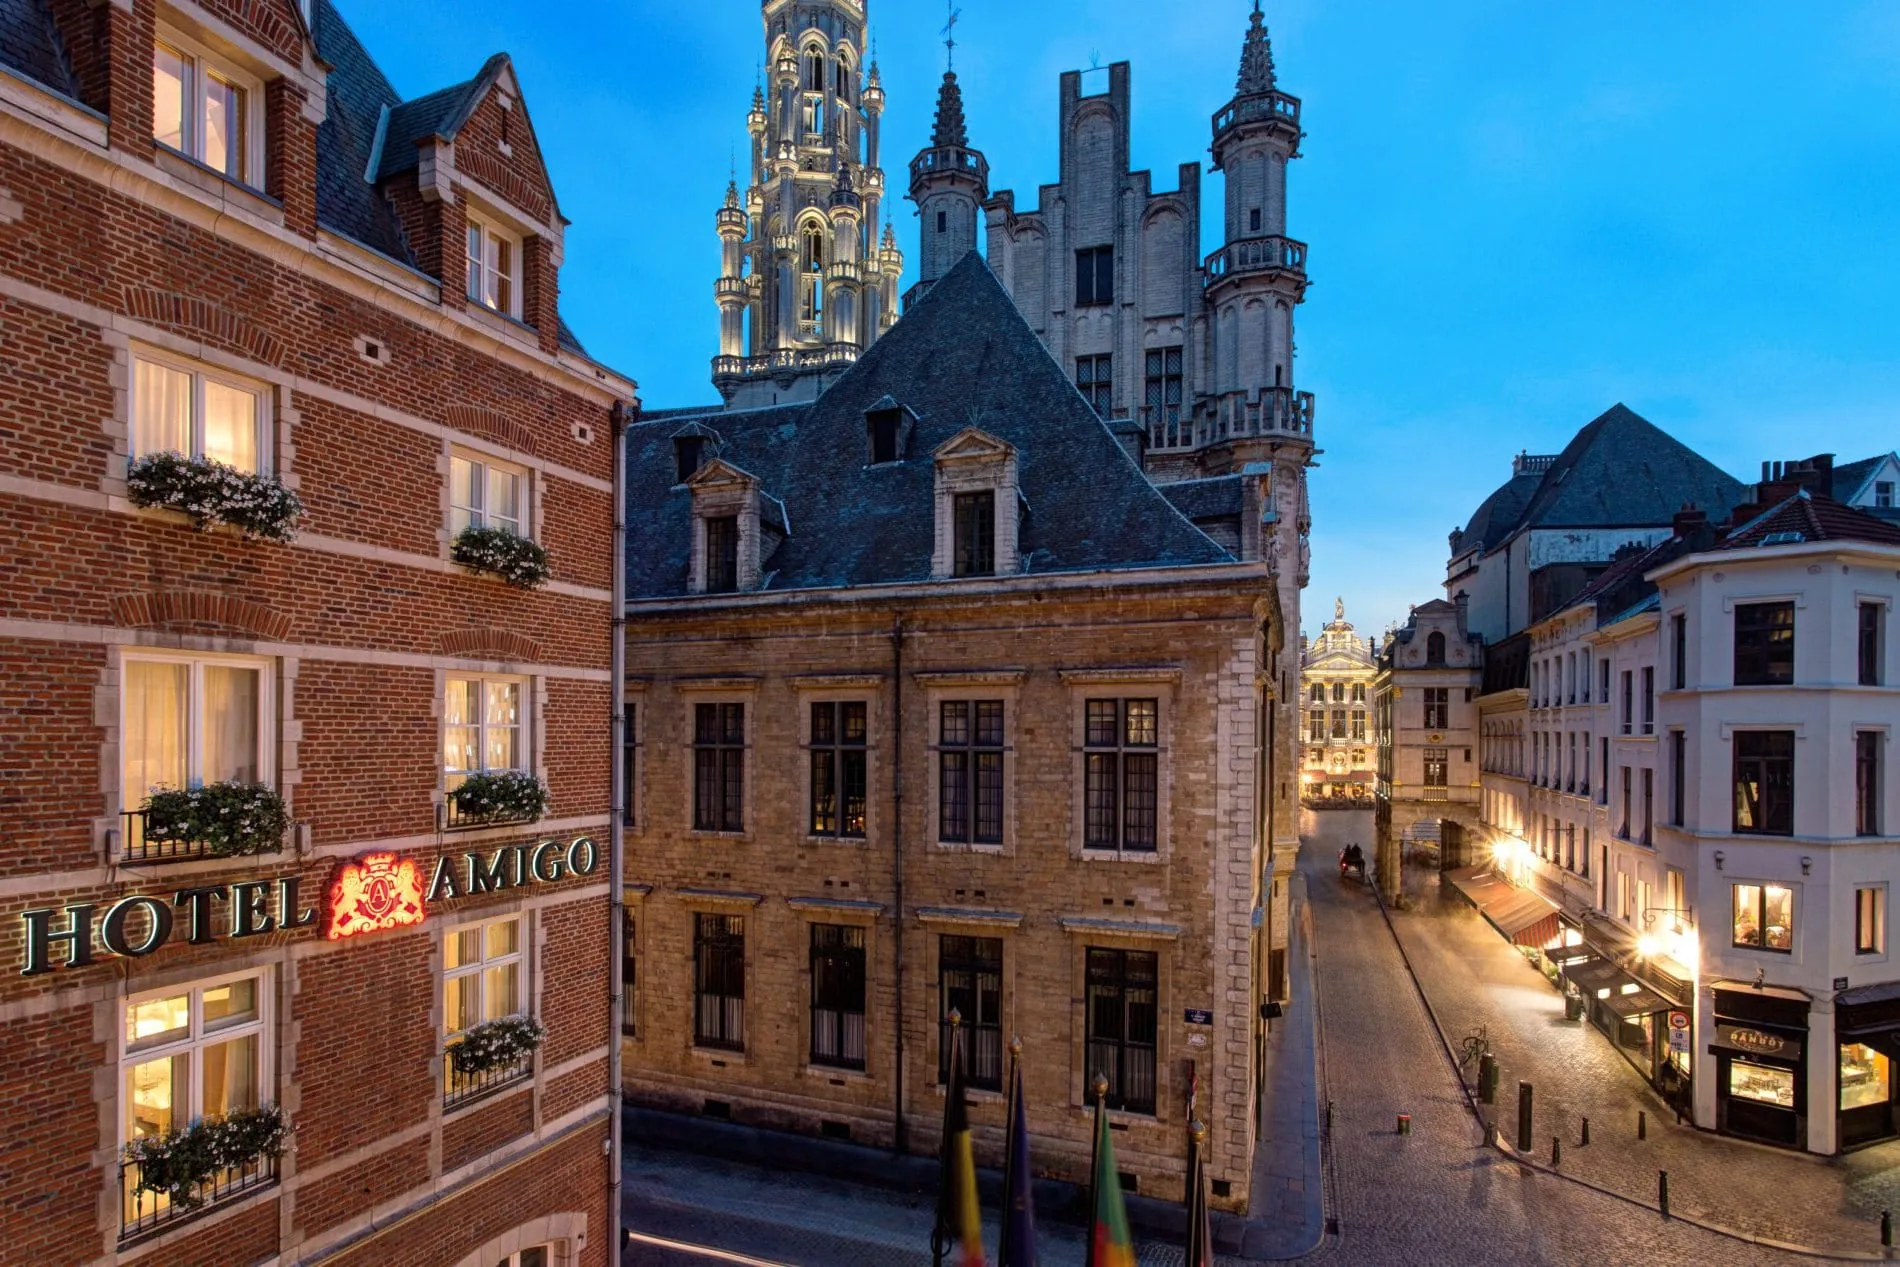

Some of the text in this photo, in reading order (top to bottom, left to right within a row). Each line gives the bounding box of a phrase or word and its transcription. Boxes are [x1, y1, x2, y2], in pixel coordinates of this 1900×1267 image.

[20, 836, 599, 976] HOTEL AMIGO
[371, 882, 388, 903] A
